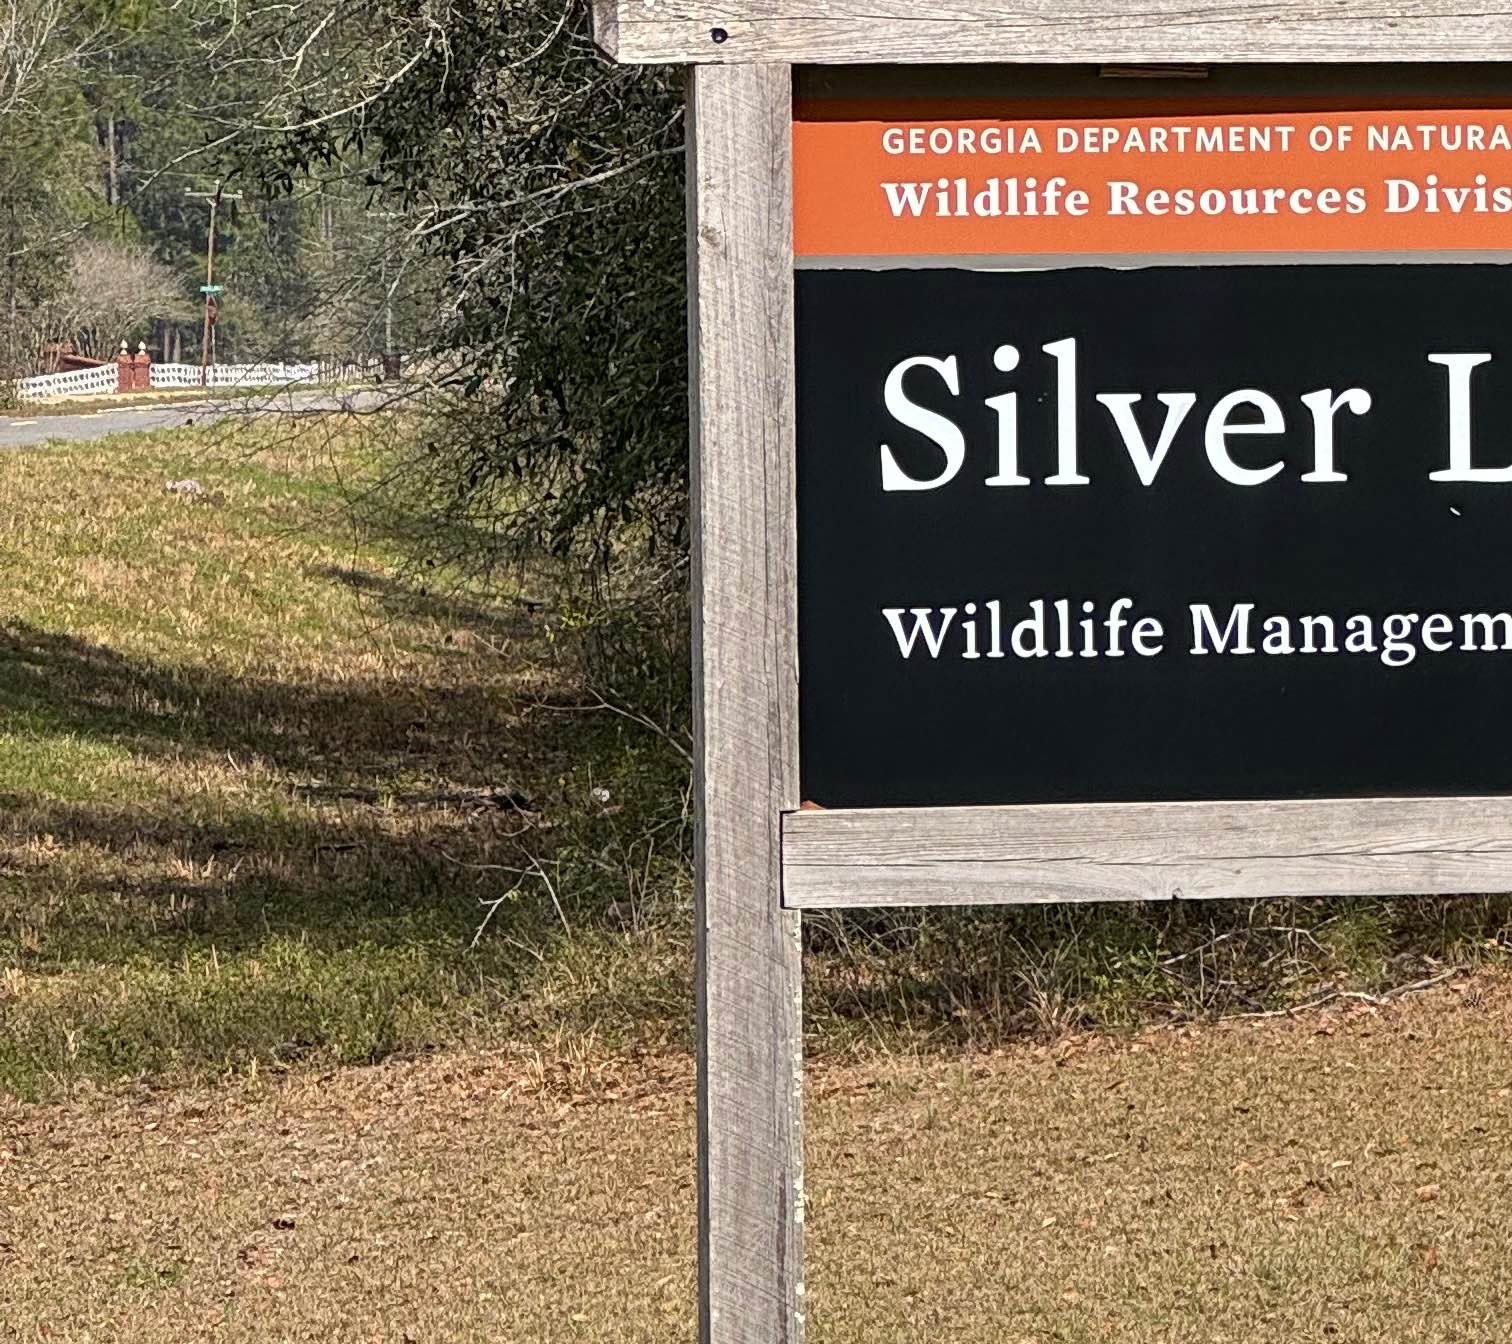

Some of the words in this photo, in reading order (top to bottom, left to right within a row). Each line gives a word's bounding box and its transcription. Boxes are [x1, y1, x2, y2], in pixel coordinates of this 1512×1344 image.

[882, 128, 1042, 154] GEORGIA
[1056, 126, 1295, 153] DEPARTMENT
[1308, 125, 1352, 151] OF
[880, 176, 1090, 217] Wildlife
[1106, 181, 1367, 216] Resources
[880, 337, 1371, 492] Silver
[882, 598, 1164, 661] Wildlife
